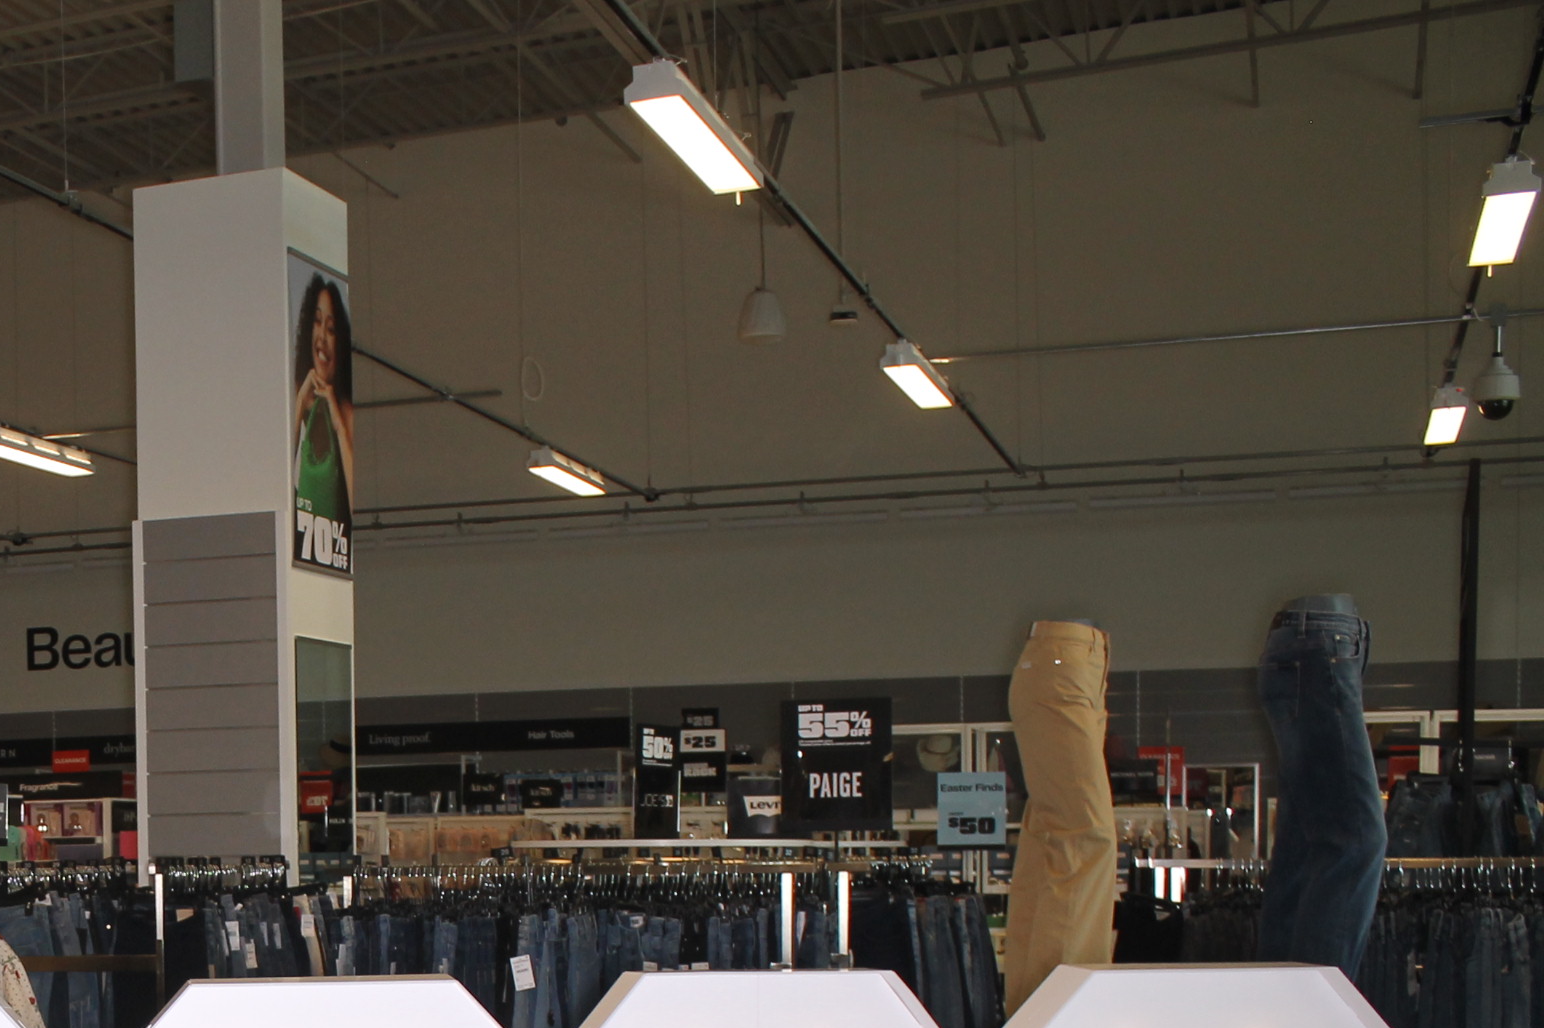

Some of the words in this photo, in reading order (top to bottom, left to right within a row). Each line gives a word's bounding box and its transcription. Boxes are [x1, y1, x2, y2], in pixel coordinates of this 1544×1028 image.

[296, 509, 348, 566] 70%
[332, 552, 349, 570] OFF
[797, 711, 872, 739] 55%
[368, 733, 401, 747] Living
[527, 730, 547, 740] Hair
[549, 729, 576, 739] Tools
[850, 728, 872, 738] OFF
[684, 735, 716, 748] $25
[19, 783, 58, 793] Fragrance
[809, 771, 863, 799] PAIGE
[940, 783, 973, 793] Easter
[975, 783, 1004, 793] Finds
[948, 817, 996, 834] $50
